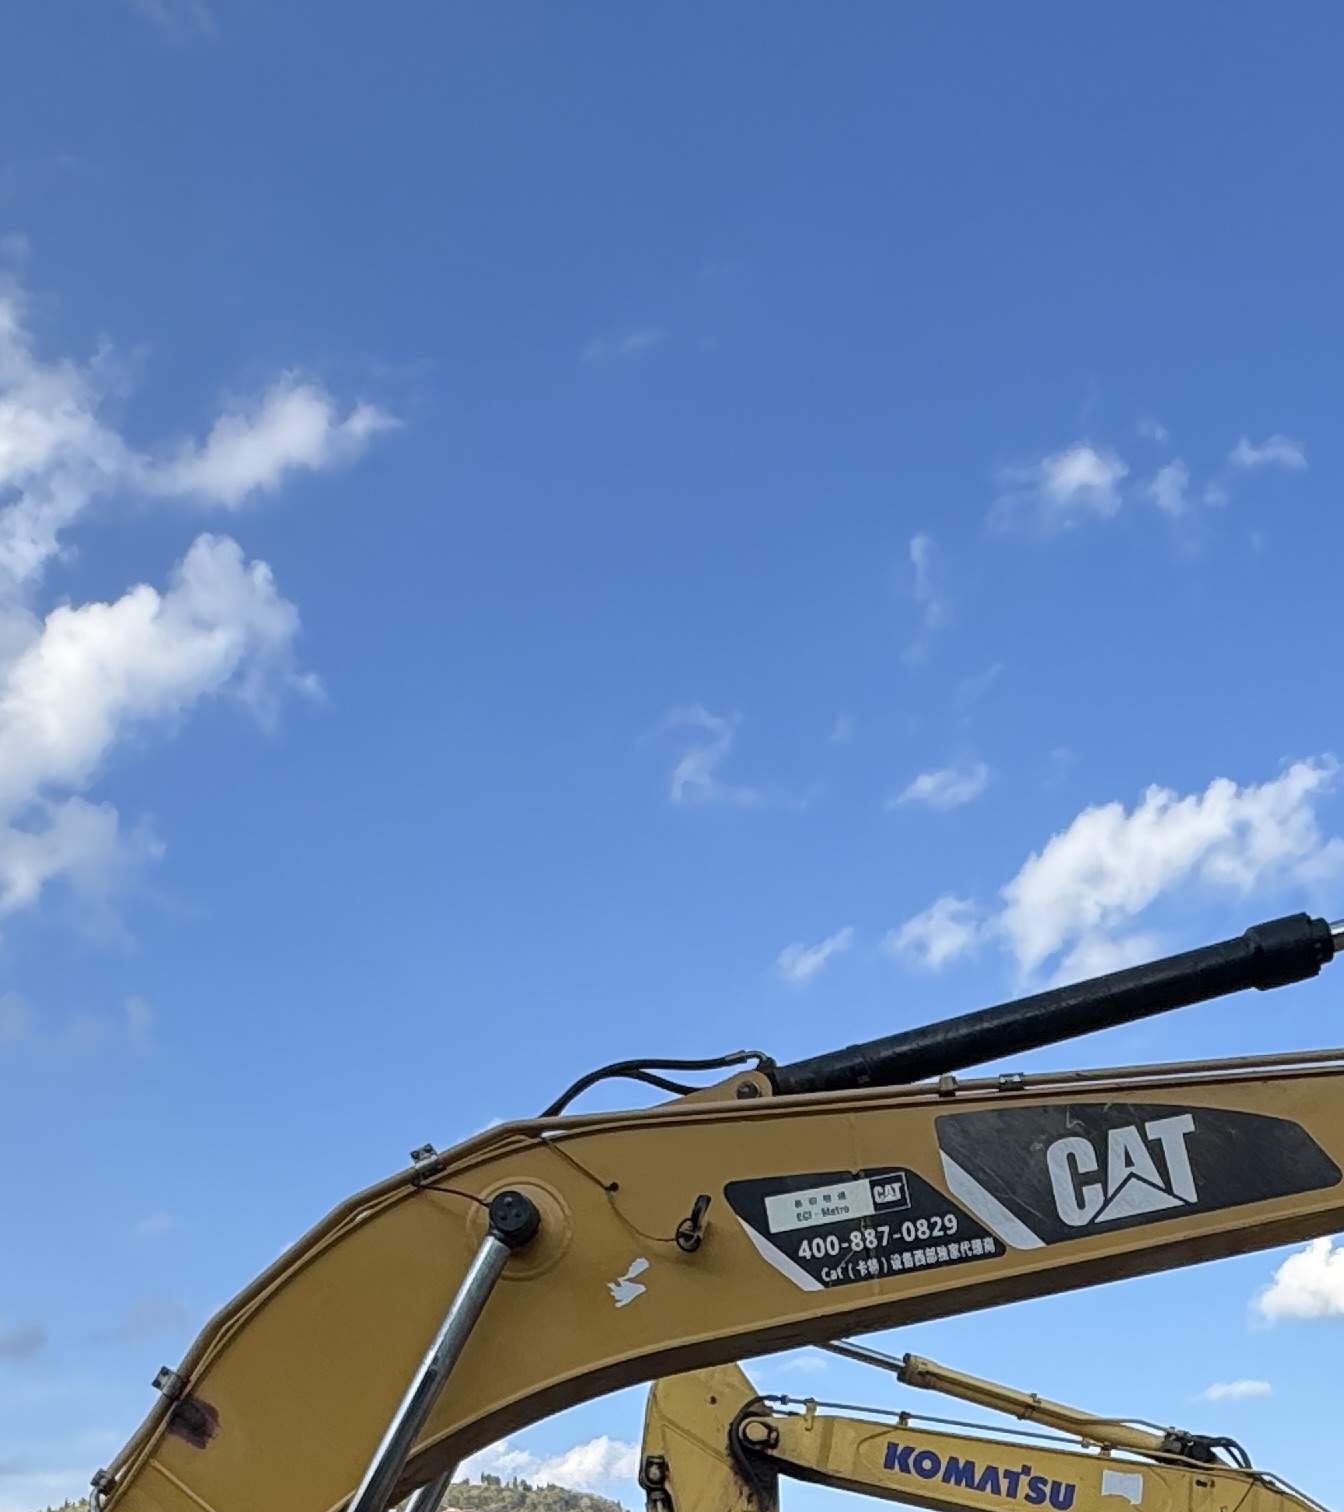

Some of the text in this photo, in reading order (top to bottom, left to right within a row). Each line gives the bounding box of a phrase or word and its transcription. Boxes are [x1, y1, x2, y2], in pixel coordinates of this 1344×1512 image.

[873, 1182, 903, 1204] CAT
[1047, 1113, 1195, 1227] CAT
[798, 1213, 958, 1260] 400-887-0829
[883, 1441, 1076, 1511] KOMATSU
